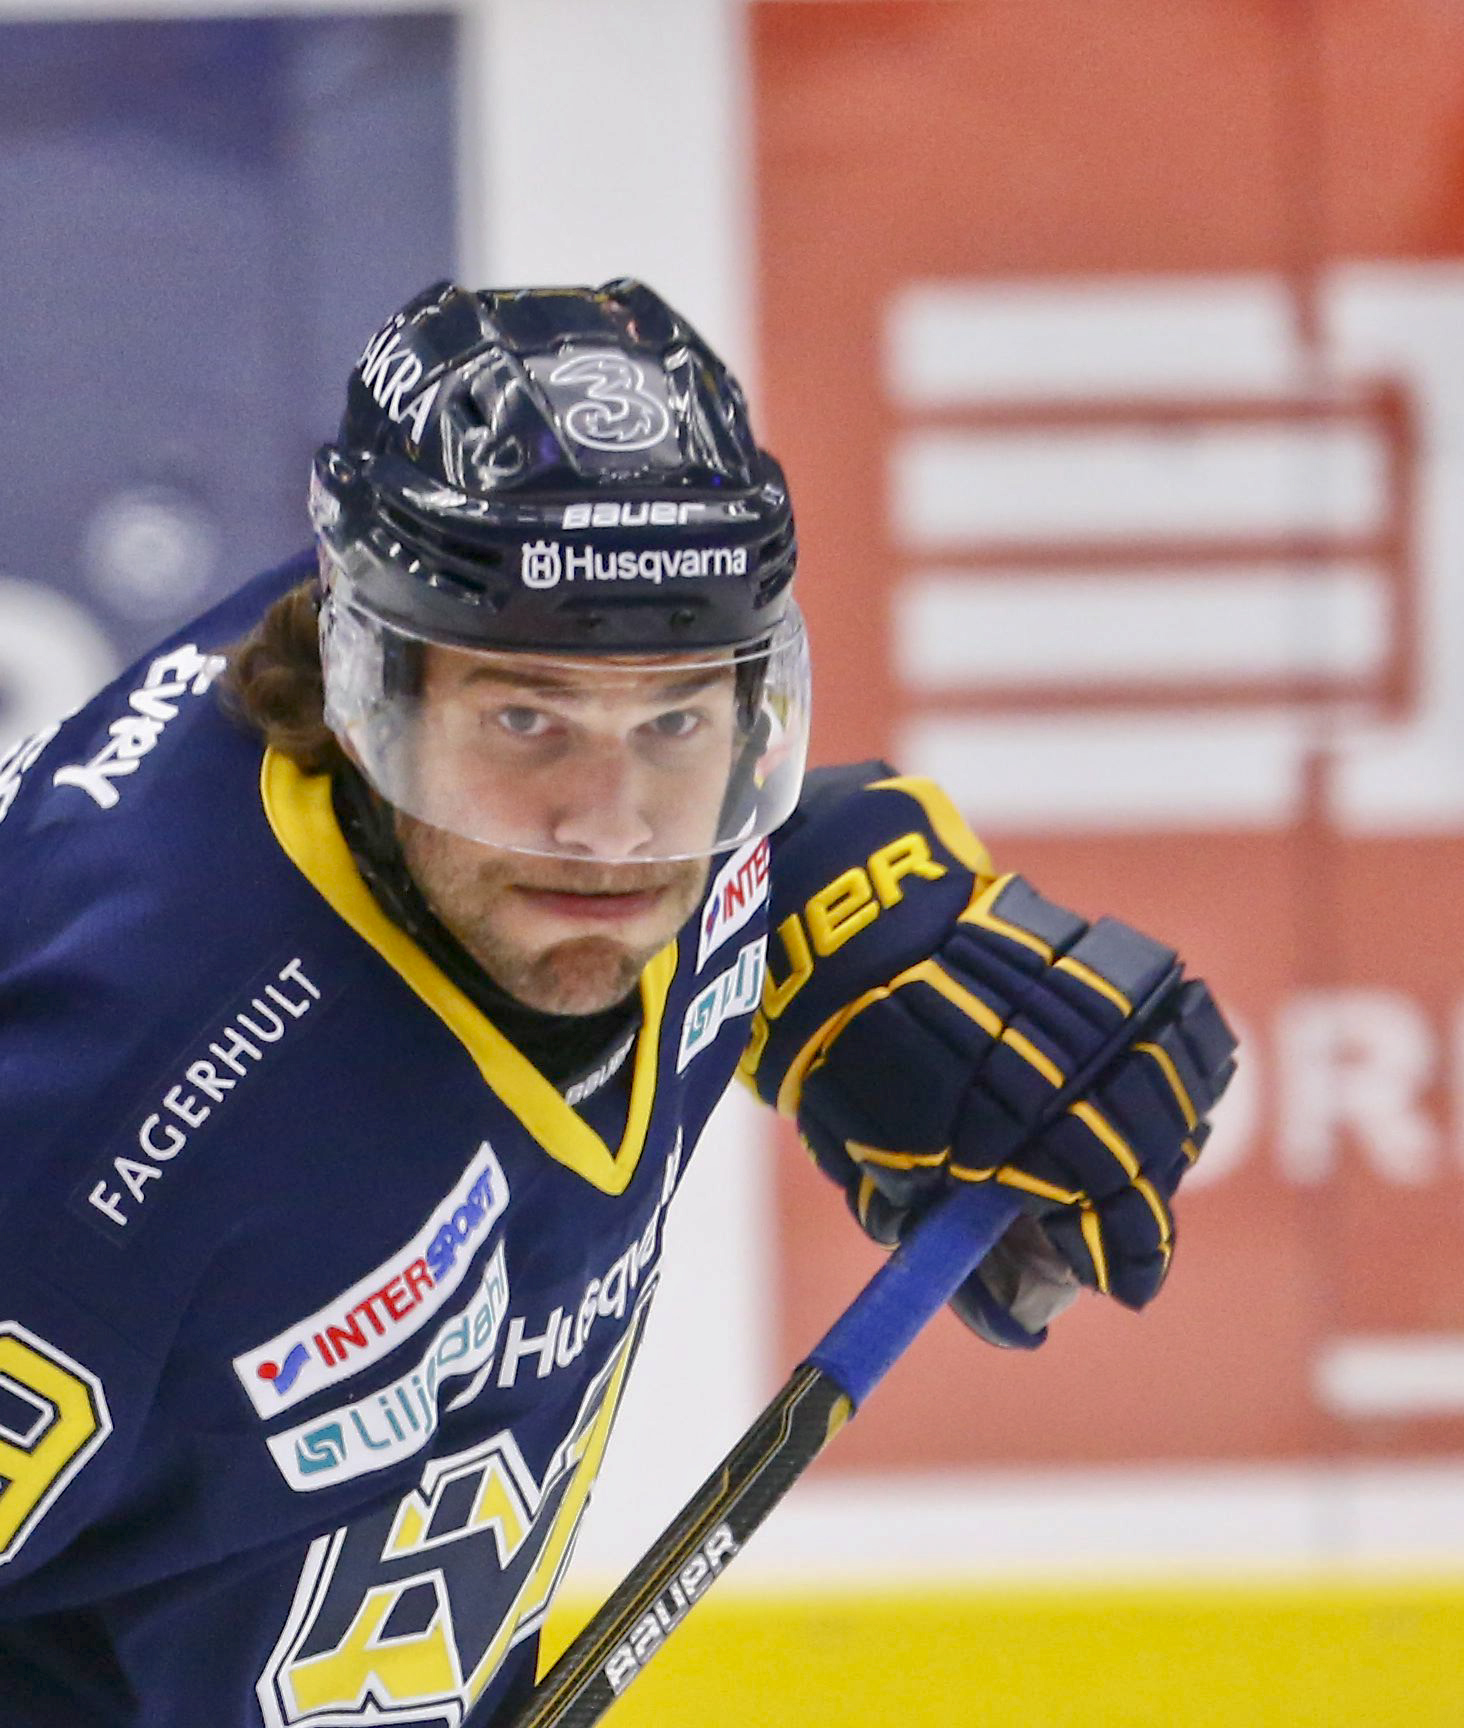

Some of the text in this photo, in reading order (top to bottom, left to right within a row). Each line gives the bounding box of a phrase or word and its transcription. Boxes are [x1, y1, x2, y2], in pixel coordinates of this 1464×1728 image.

[565, 546, 747, 585] Husqvarna
[88, 957, 321, 1226] FAGERHULT
[315, 1164, 494, 1368] INTERSPORT
[605, 1521, 741, 1697] BAUER
